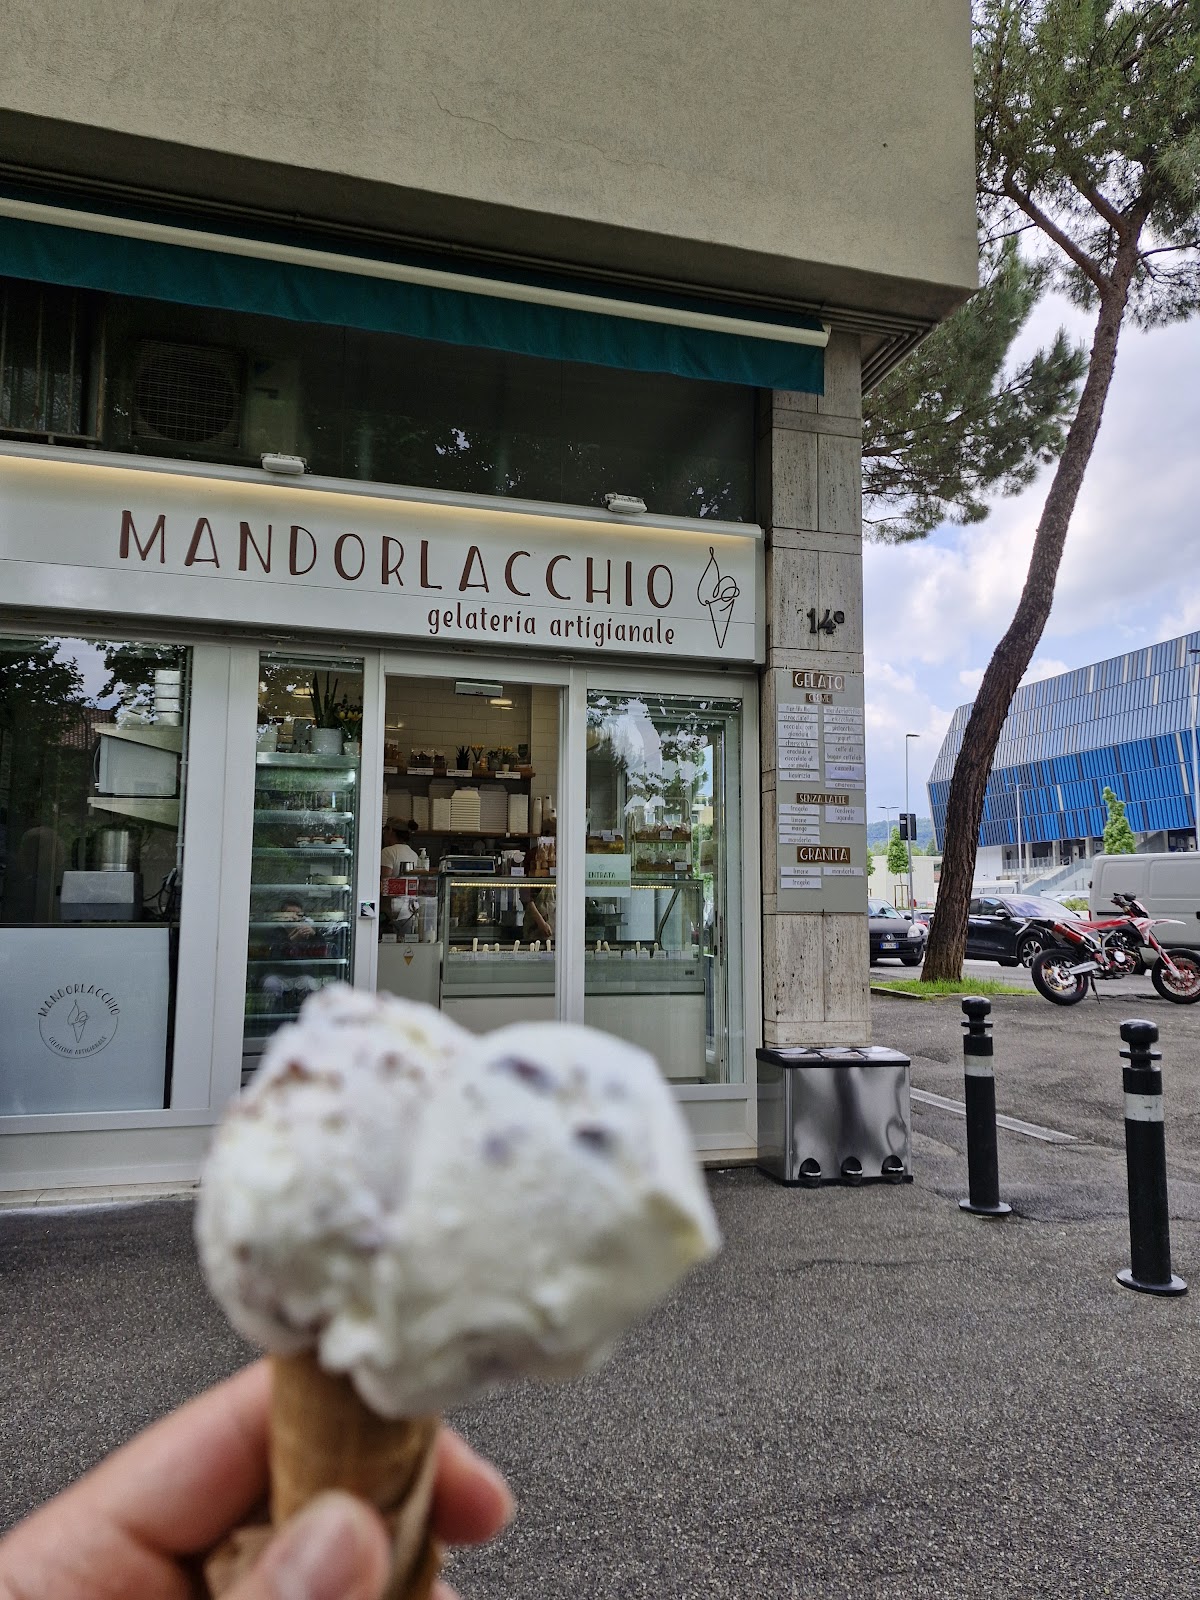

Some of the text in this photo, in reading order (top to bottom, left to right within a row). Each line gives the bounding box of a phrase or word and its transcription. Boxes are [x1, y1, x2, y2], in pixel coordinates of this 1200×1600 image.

[118, 509, 675, 609] MANDORLACCHIO
[427, 602, 676, 647] gelateria artigianale
[794, 672, 843, 690] GELATO
[800, 794, 846, 804] SENZA LATTE
[800, 847, 848, 861] GRANITA
[588, 871, 616, 879] ENTRATA
[37, 983, 121, 1017] MANDORLACCHIO
